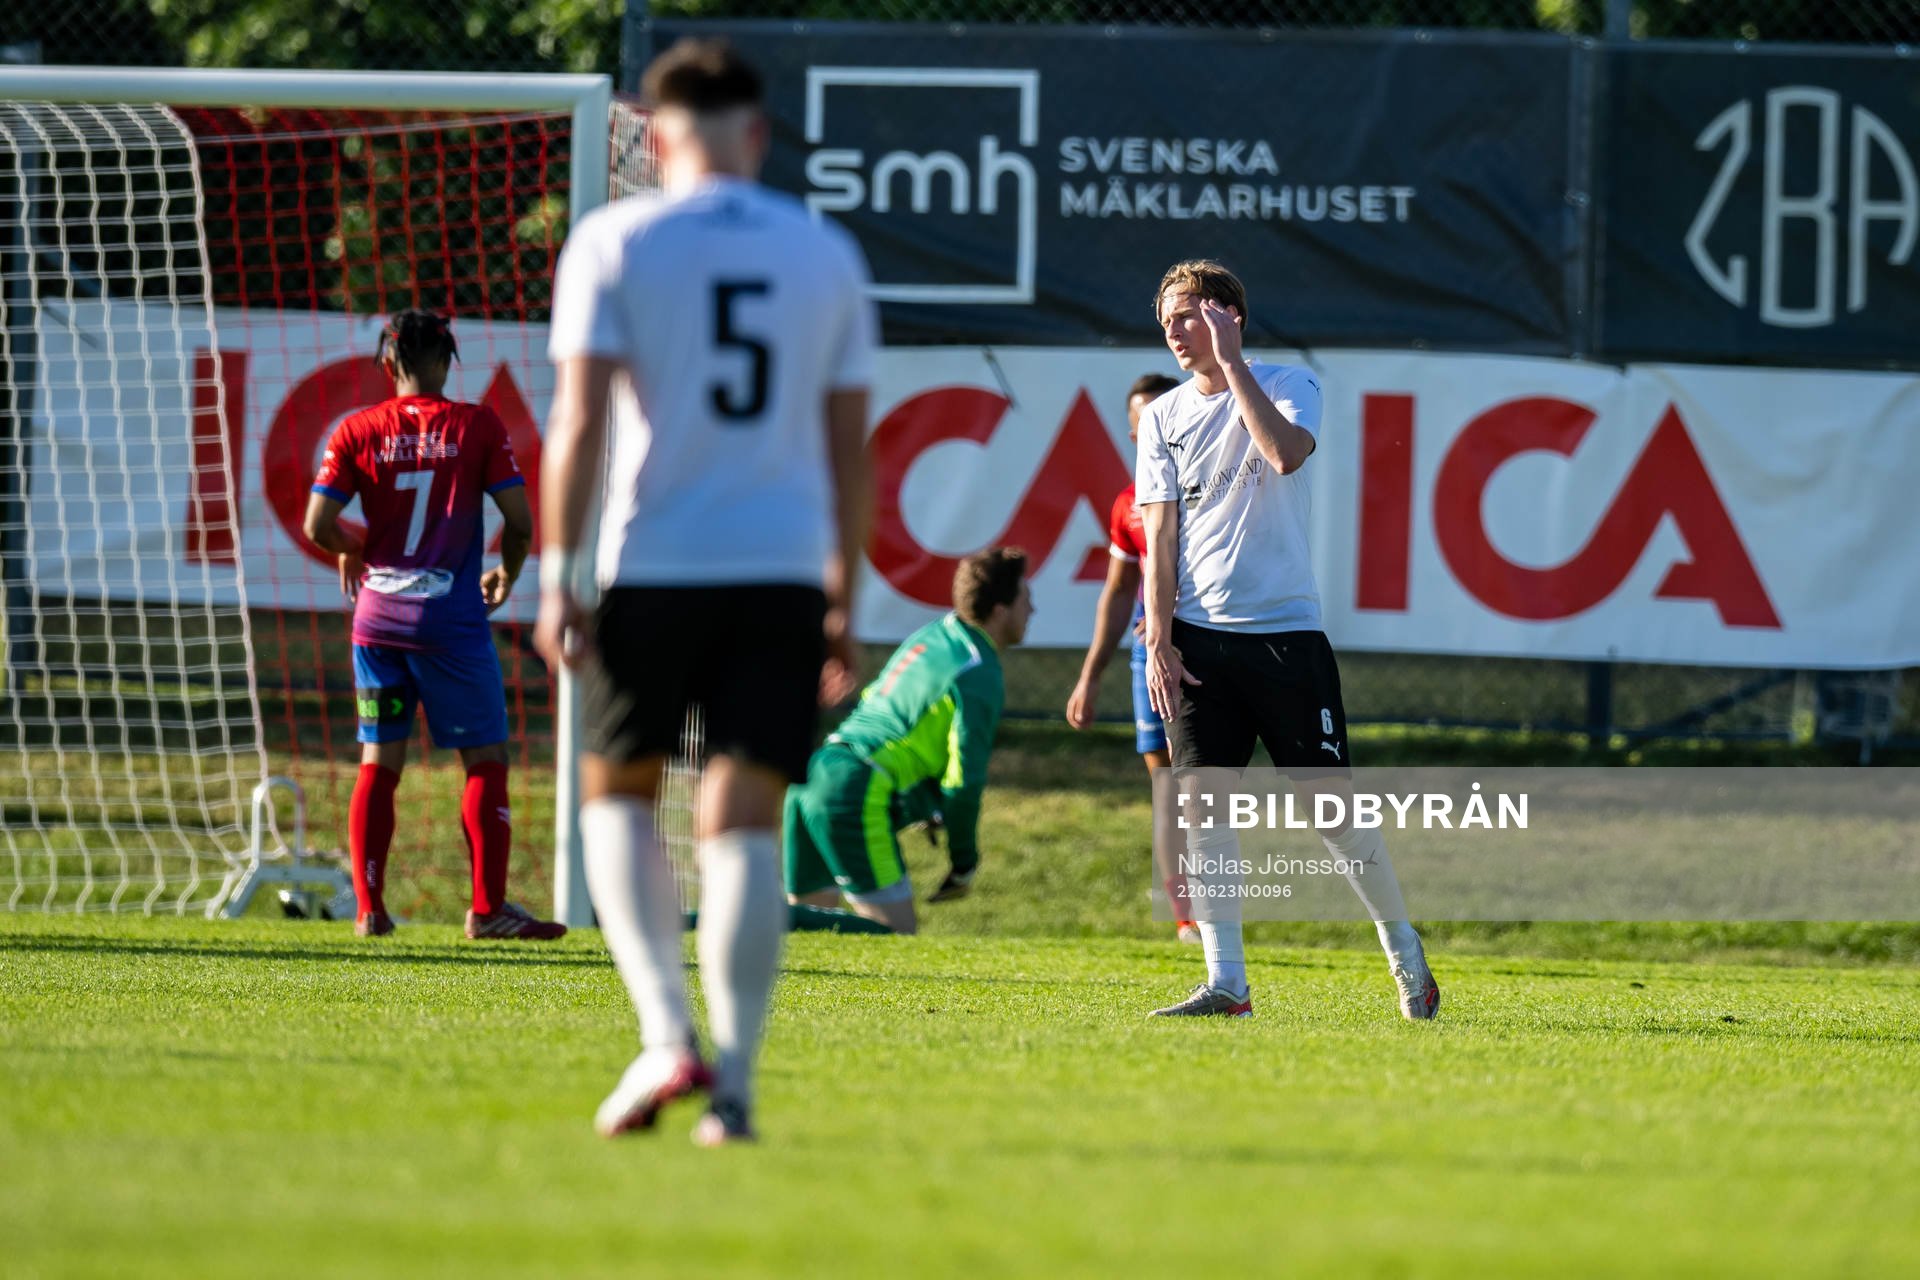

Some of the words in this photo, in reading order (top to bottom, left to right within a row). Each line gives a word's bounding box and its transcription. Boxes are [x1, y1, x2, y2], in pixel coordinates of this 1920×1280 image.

[805, 135, 1037, 215] smh
[1059, 137, 1279, 175] SVENSKA
[1059, 177, 1415, 222] MÄKLARHUSET
[710, 278, 773, 421] 5
[395, 470, 435, 556] 7
[862, 385, 1138, 611] CA
[1356, 391, 1785, 631] ICA
[1321, 708, 1333, 734] 6
